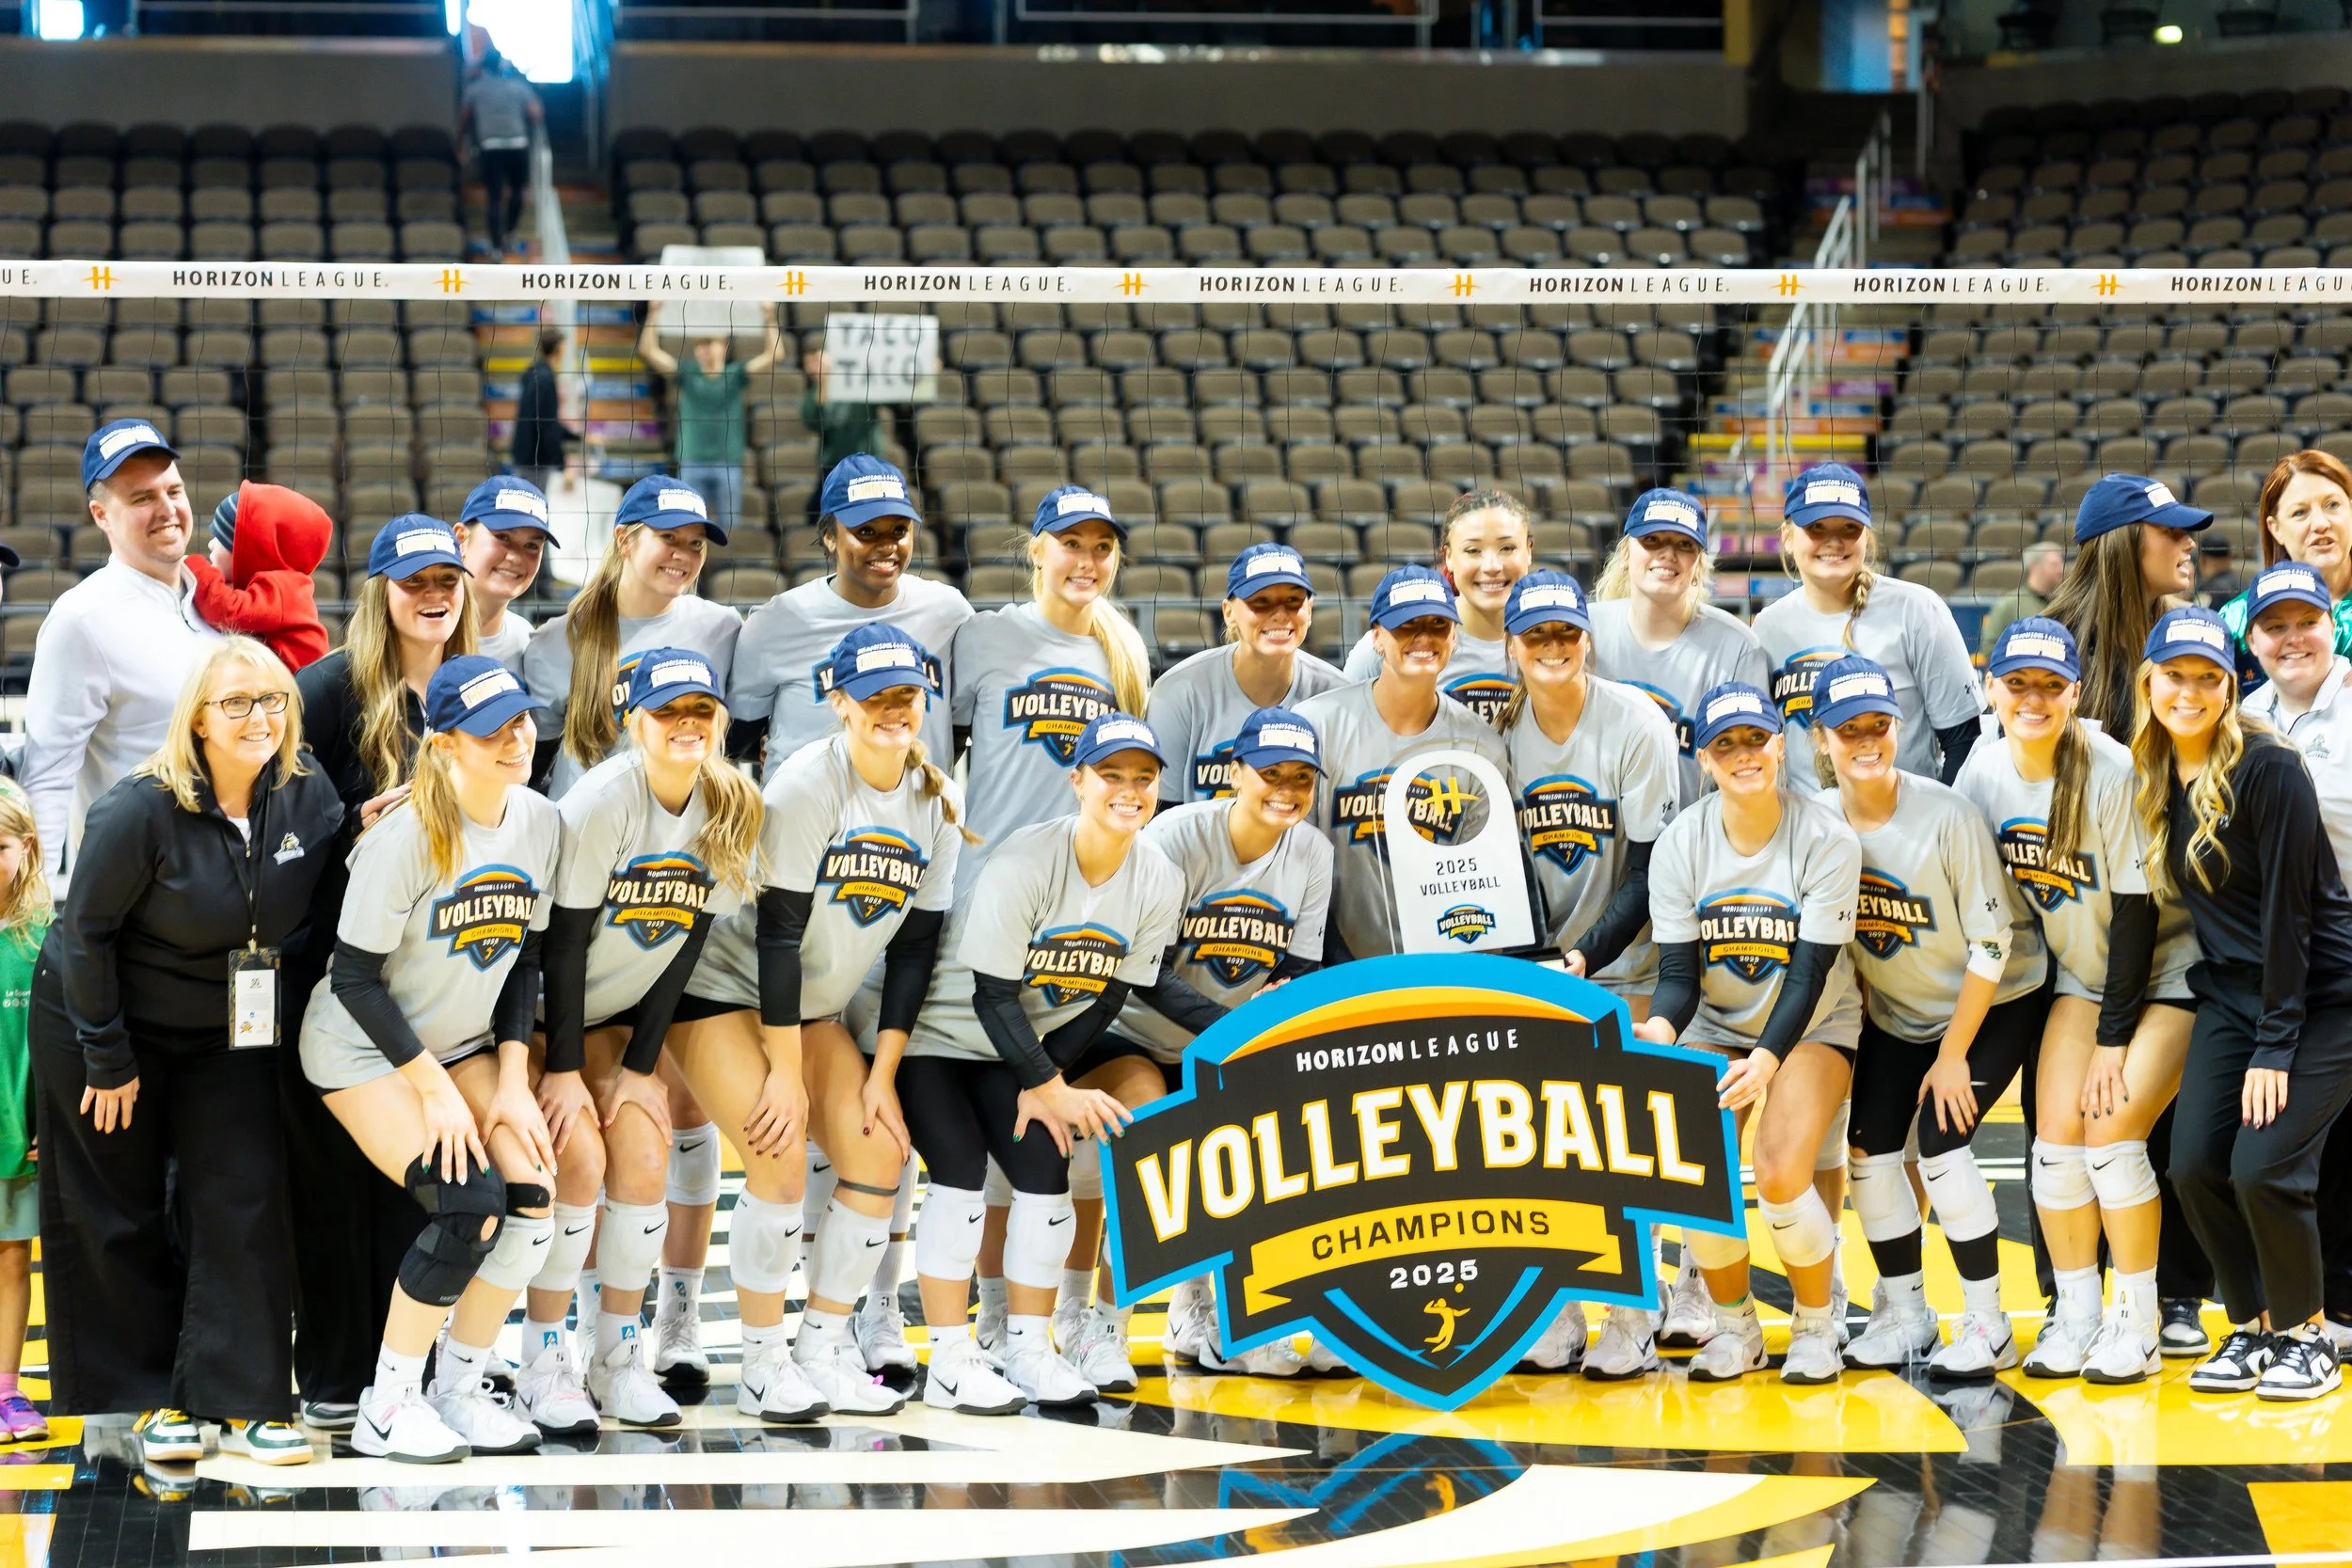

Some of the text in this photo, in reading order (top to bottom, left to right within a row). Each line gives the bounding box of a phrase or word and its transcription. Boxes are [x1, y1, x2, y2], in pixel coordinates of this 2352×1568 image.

[173, 270, 274, 288] HORIZON
[521, 273, 621, 290] HORIZON
[864, 275, 961, 291] HORIZON
[1200, 276, 1295, 293] HORIZON
[1529, 277, 1624, 293] HORIZON
[1853, 277, 1946, 293] HORIZON
[2170, 276, 2352, 293] HORIZON LEAGU
[1436, 857, 1477, 876] 2025
[1420, 876, 1501, 896] VOLLEYBALL
[1438, 913, 1493, 931] VOLLEYBALL
[1700, 915, 1797, 942] OLLEYBAL
[1295, 1028, 1518, 1072] HORIZON LEAGUE
[1135, 1079, 1706, 1243] VOLLEYBALL
[1311, 1210, 1550, 1261] CHAMPIONS
[1389, 1259, 1479, 1291] 2025
